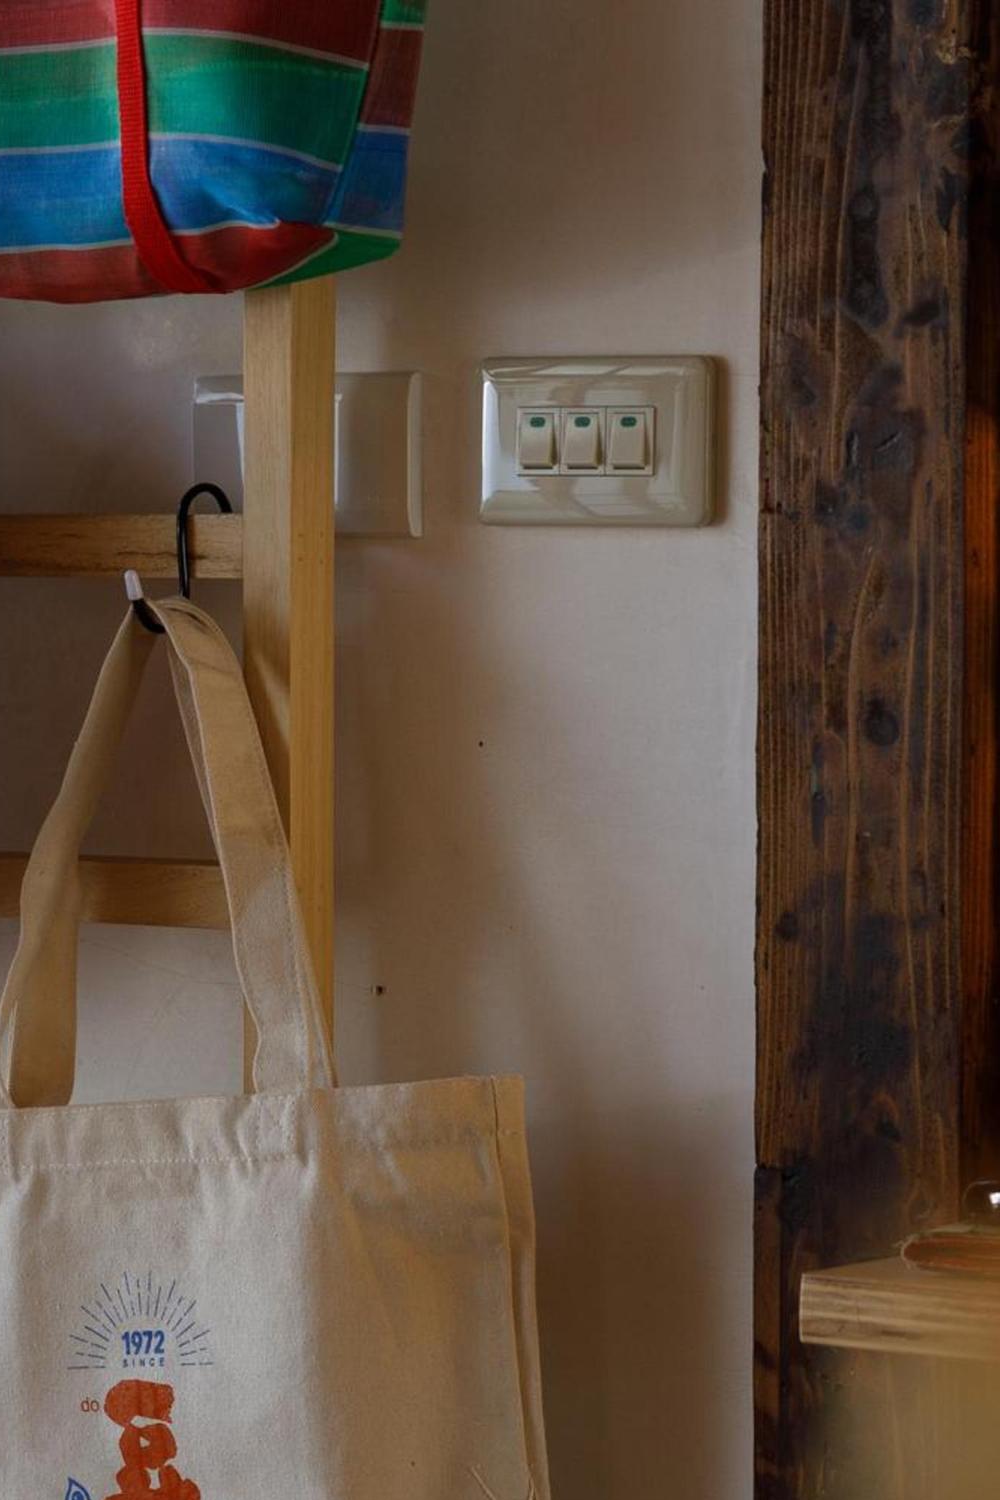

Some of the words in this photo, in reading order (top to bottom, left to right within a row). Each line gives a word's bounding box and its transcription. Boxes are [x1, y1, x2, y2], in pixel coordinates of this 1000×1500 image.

[121, 1330, 165, 1355] 1972
[122, 1357, 166, 1368] SINCE
[80, 1397, 100, 1412] do
